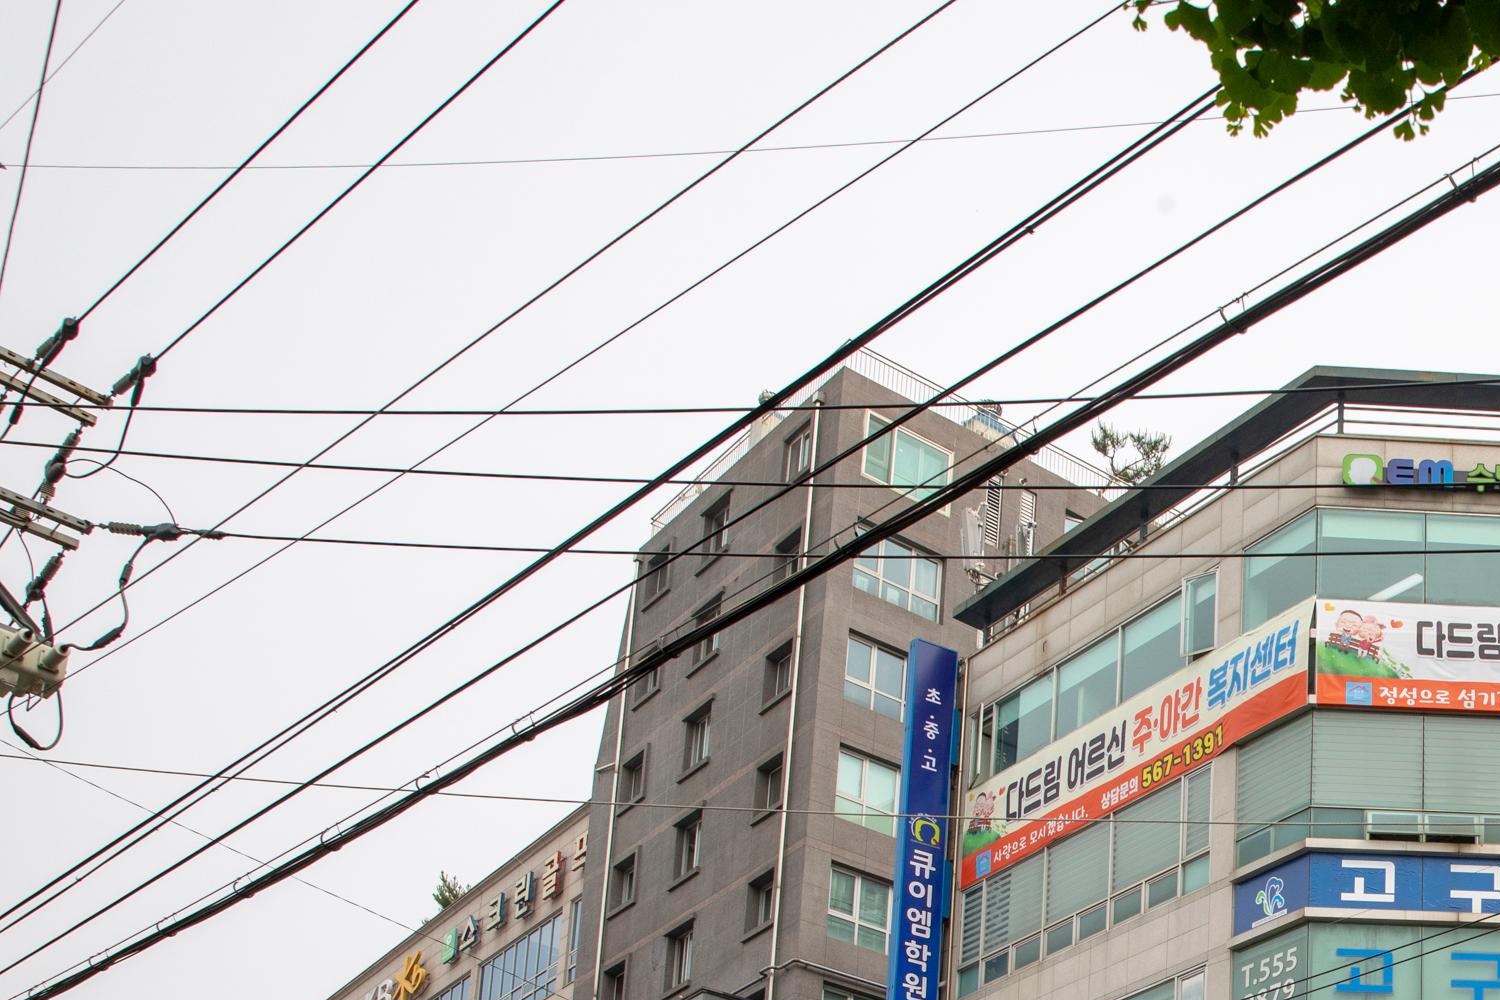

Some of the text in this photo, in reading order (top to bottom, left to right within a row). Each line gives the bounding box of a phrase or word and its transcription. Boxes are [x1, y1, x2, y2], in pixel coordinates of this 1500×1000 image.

[1005, 756, 1062, 821] 다드림
[1067, 719, 1127, 790] 어르신
[1207, 619, 1299, 708] 복지센터
[1379, 686, 1450, 707] 정성으로
[993, 726, 1224, 864] 사랑으로 모시겠습니다. 상담문의 567-1391
[1241, 947, 1300, 990] T.555
